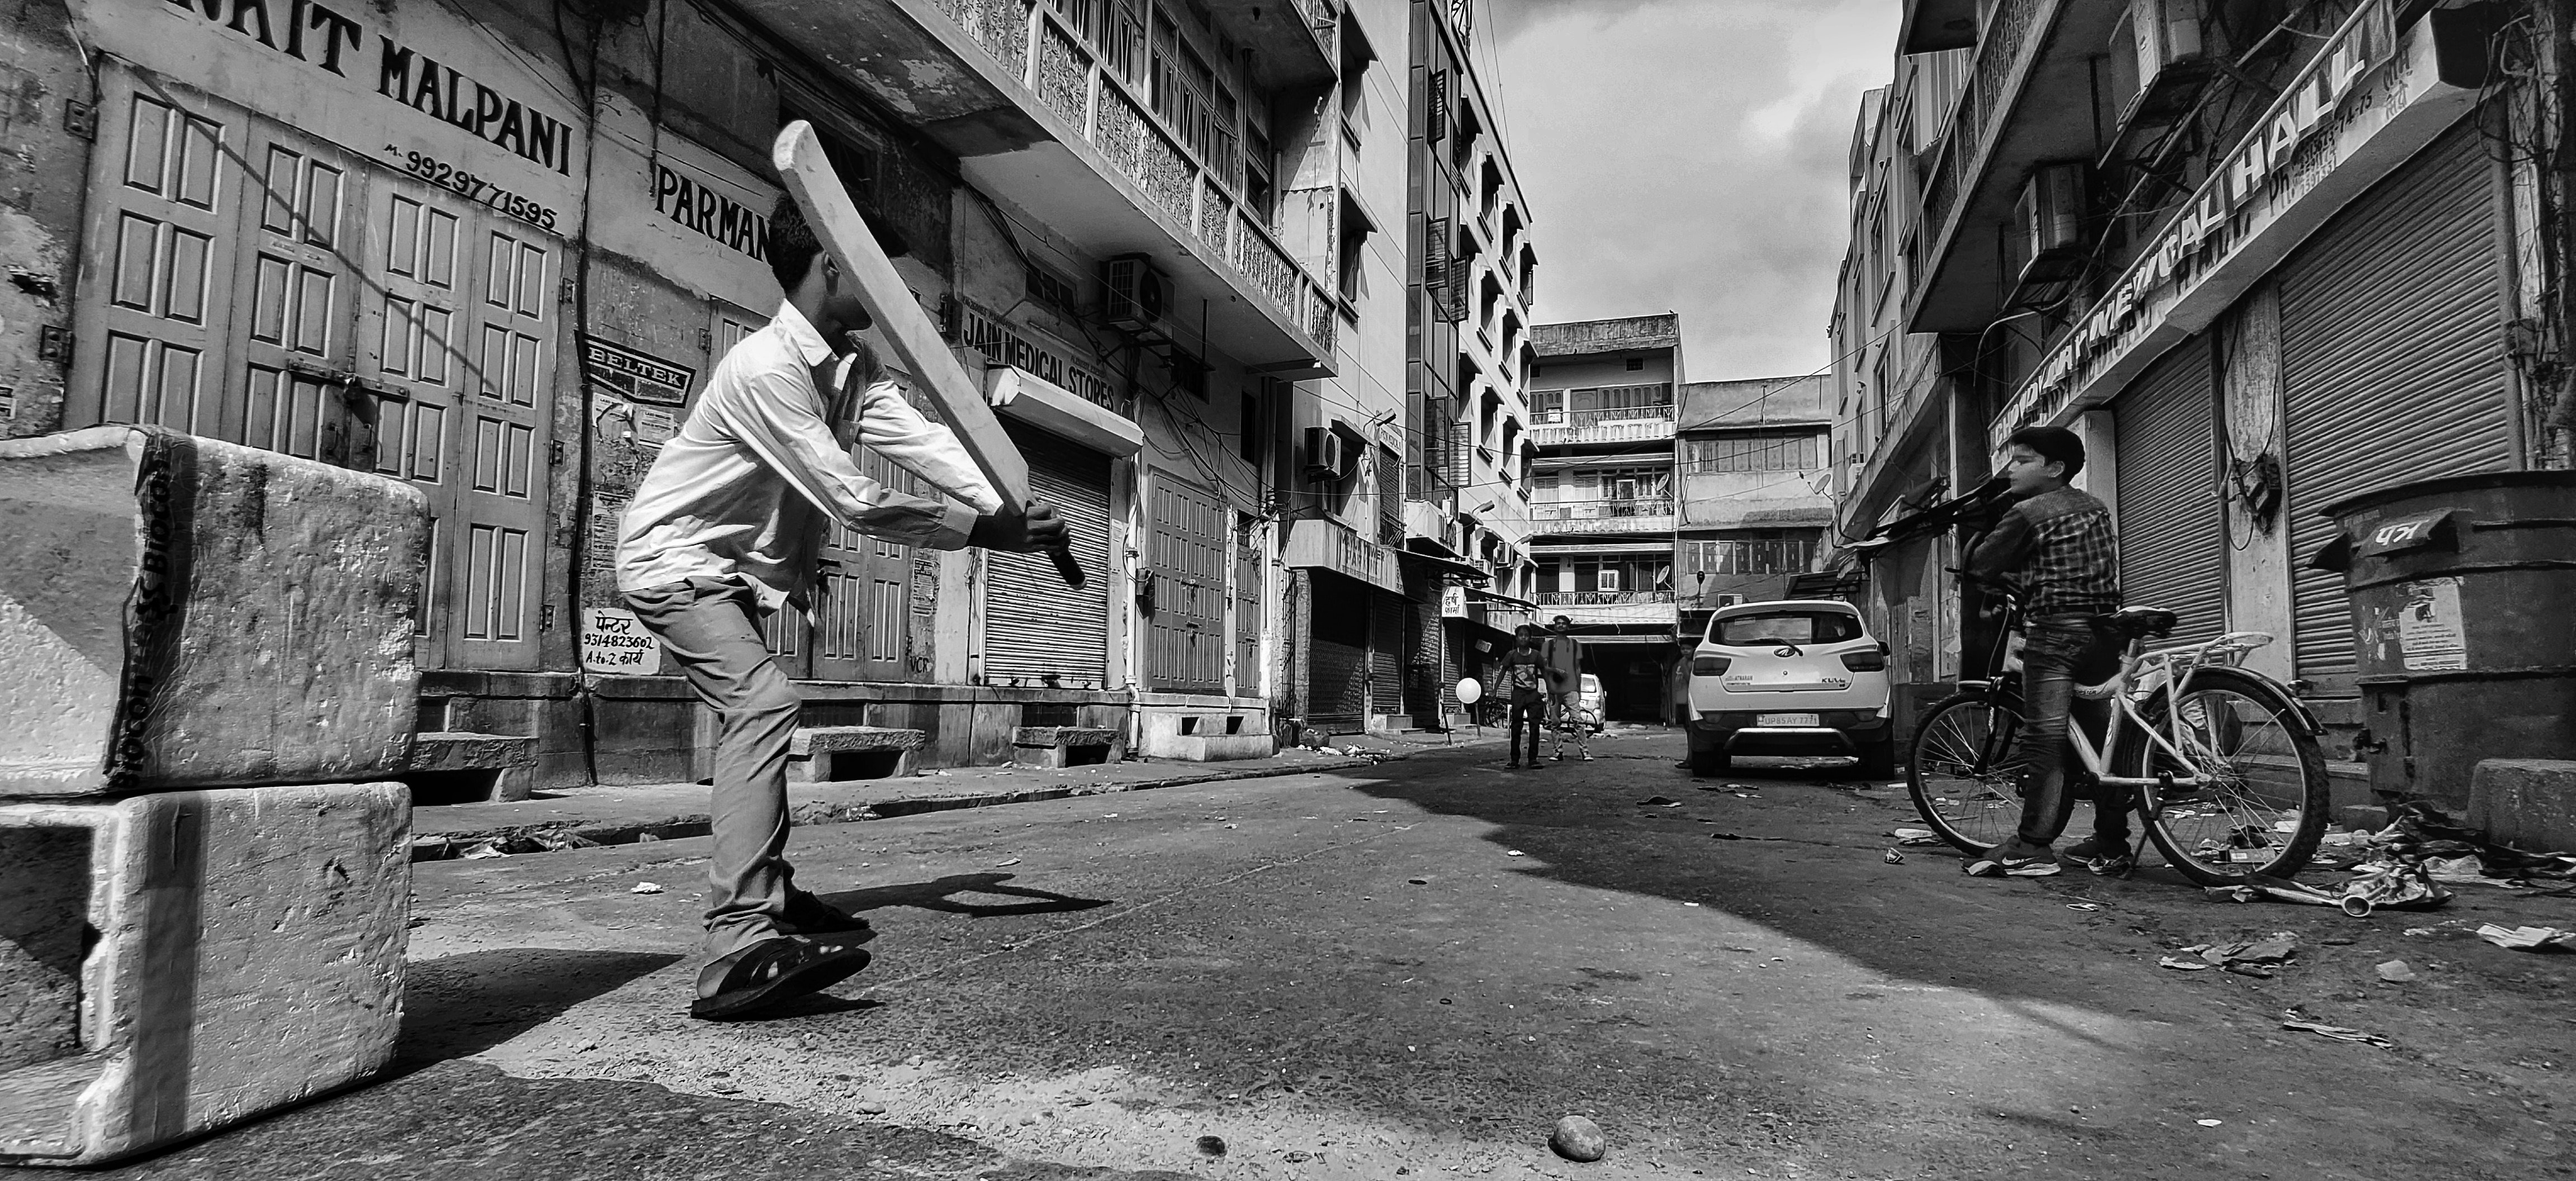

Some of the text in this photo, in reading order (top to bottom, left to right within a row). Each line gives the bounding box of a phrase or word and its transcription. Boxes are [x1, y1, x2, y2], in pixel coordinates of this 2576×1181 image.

[375, 34, 572, 177] MALPANI
[2233, 46, 2365, 201] HALL
[406, 150, 558, 229] 9929771595
[588, 347, 681, 386] BELTEK
[963, 311, 1003, 362] JAIN
[1005, 330, 1066, 389] MEDICAL
[1068, 366, 1115, 413] STORES
[1445, 593, 1459, 606] हर्ष
[584, 633, 655, 650] 9314823602
[595, 610, 634, 635] पेन्टर
[619, 649, 645, 665] कार्य
